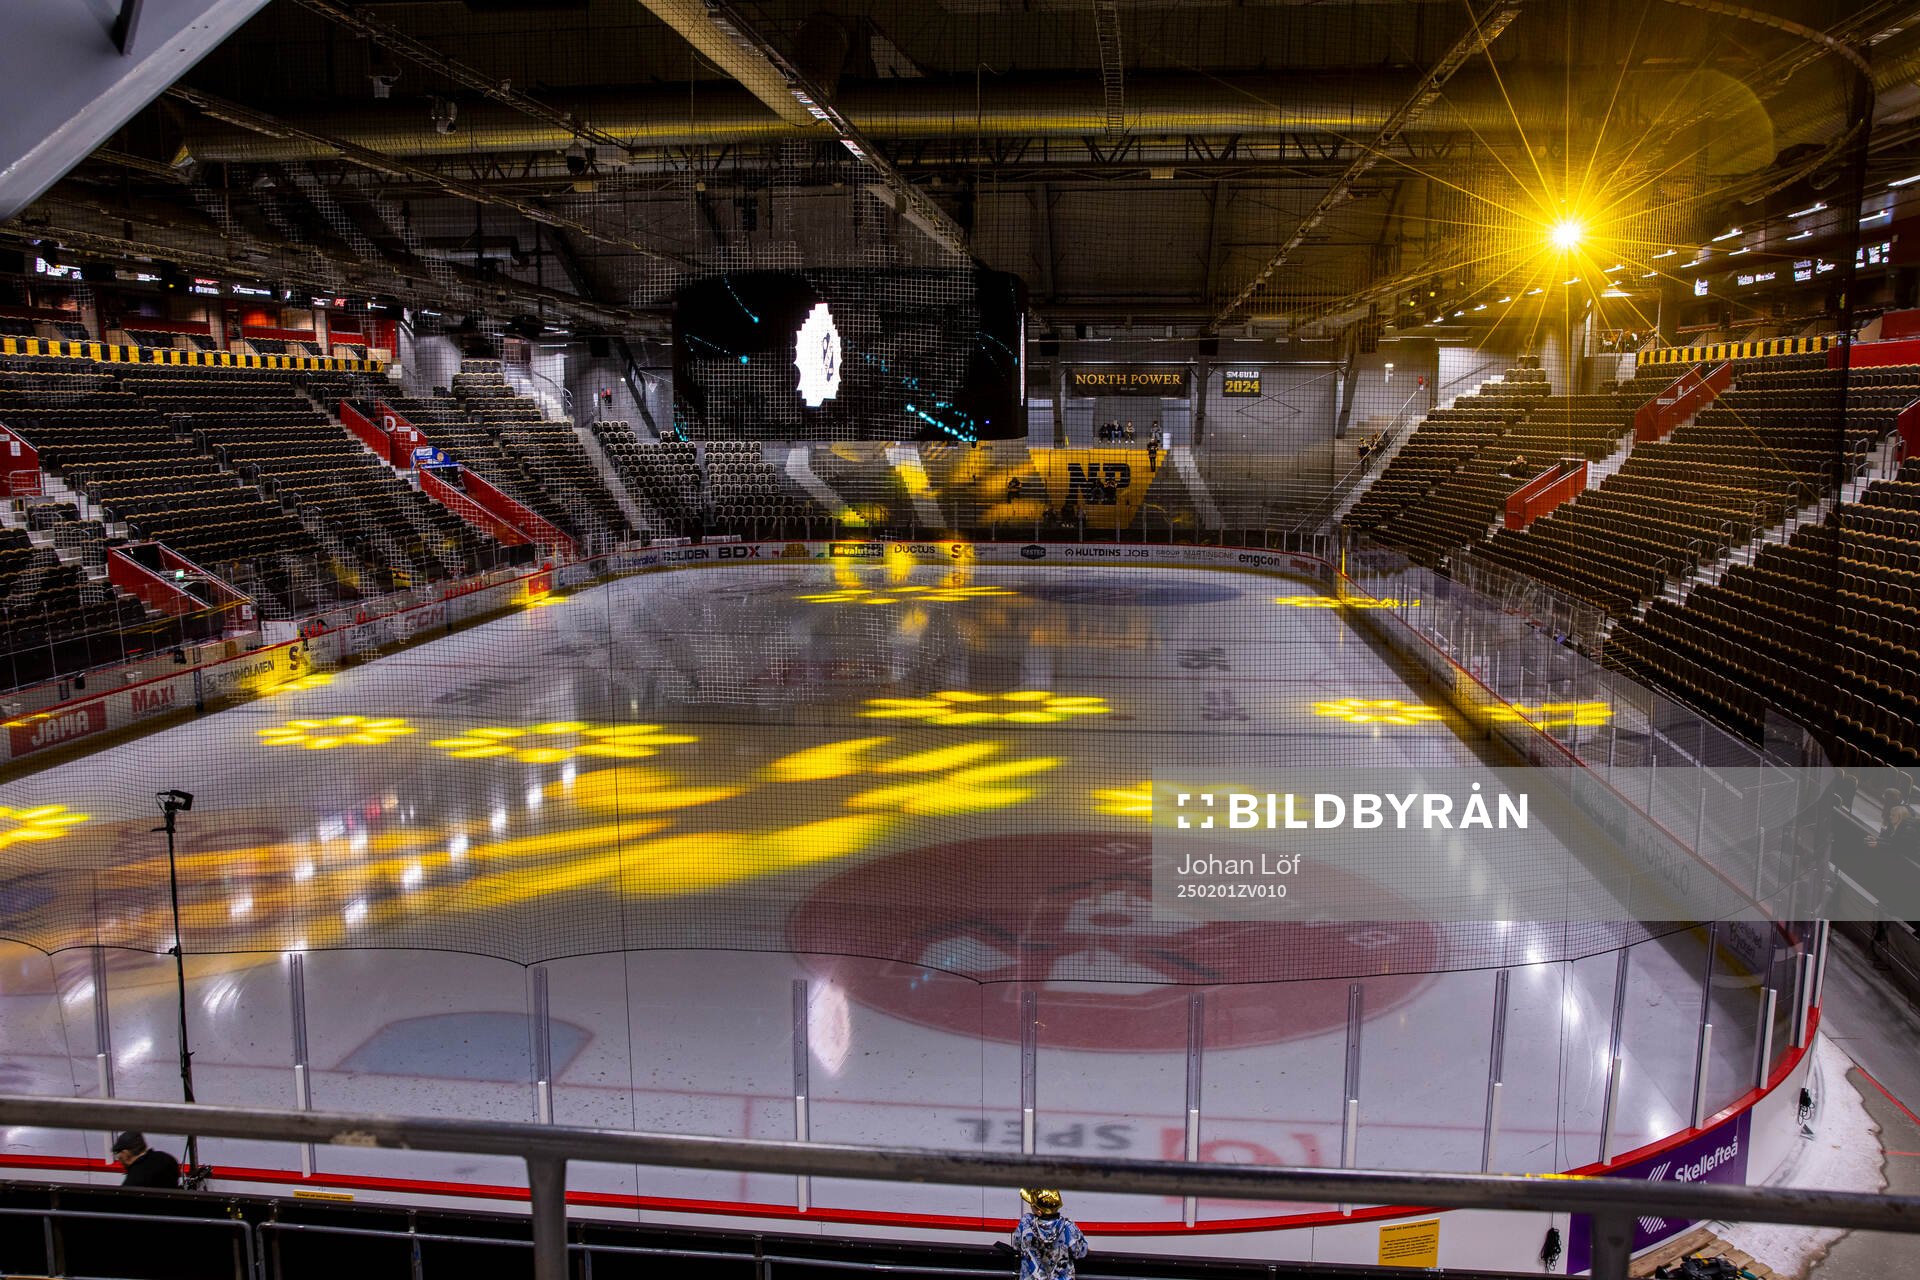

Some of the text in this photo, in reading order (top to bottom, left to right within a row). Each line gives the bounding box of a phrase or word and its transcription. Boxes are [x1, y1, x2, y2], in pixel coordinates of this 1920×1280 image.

[1075, 373, 1183, 385] NORTH POWER
[1225, 380, 1260, 393] 2024
[384, 416, 396, 431] D
[718, 546, 760, 559] BDX
[1075, 549, 1121, 557] HULTDINS
[1238, 552, 1280, 567] engcon
[1675, 1135, 1739, 1183] Skellefteå
